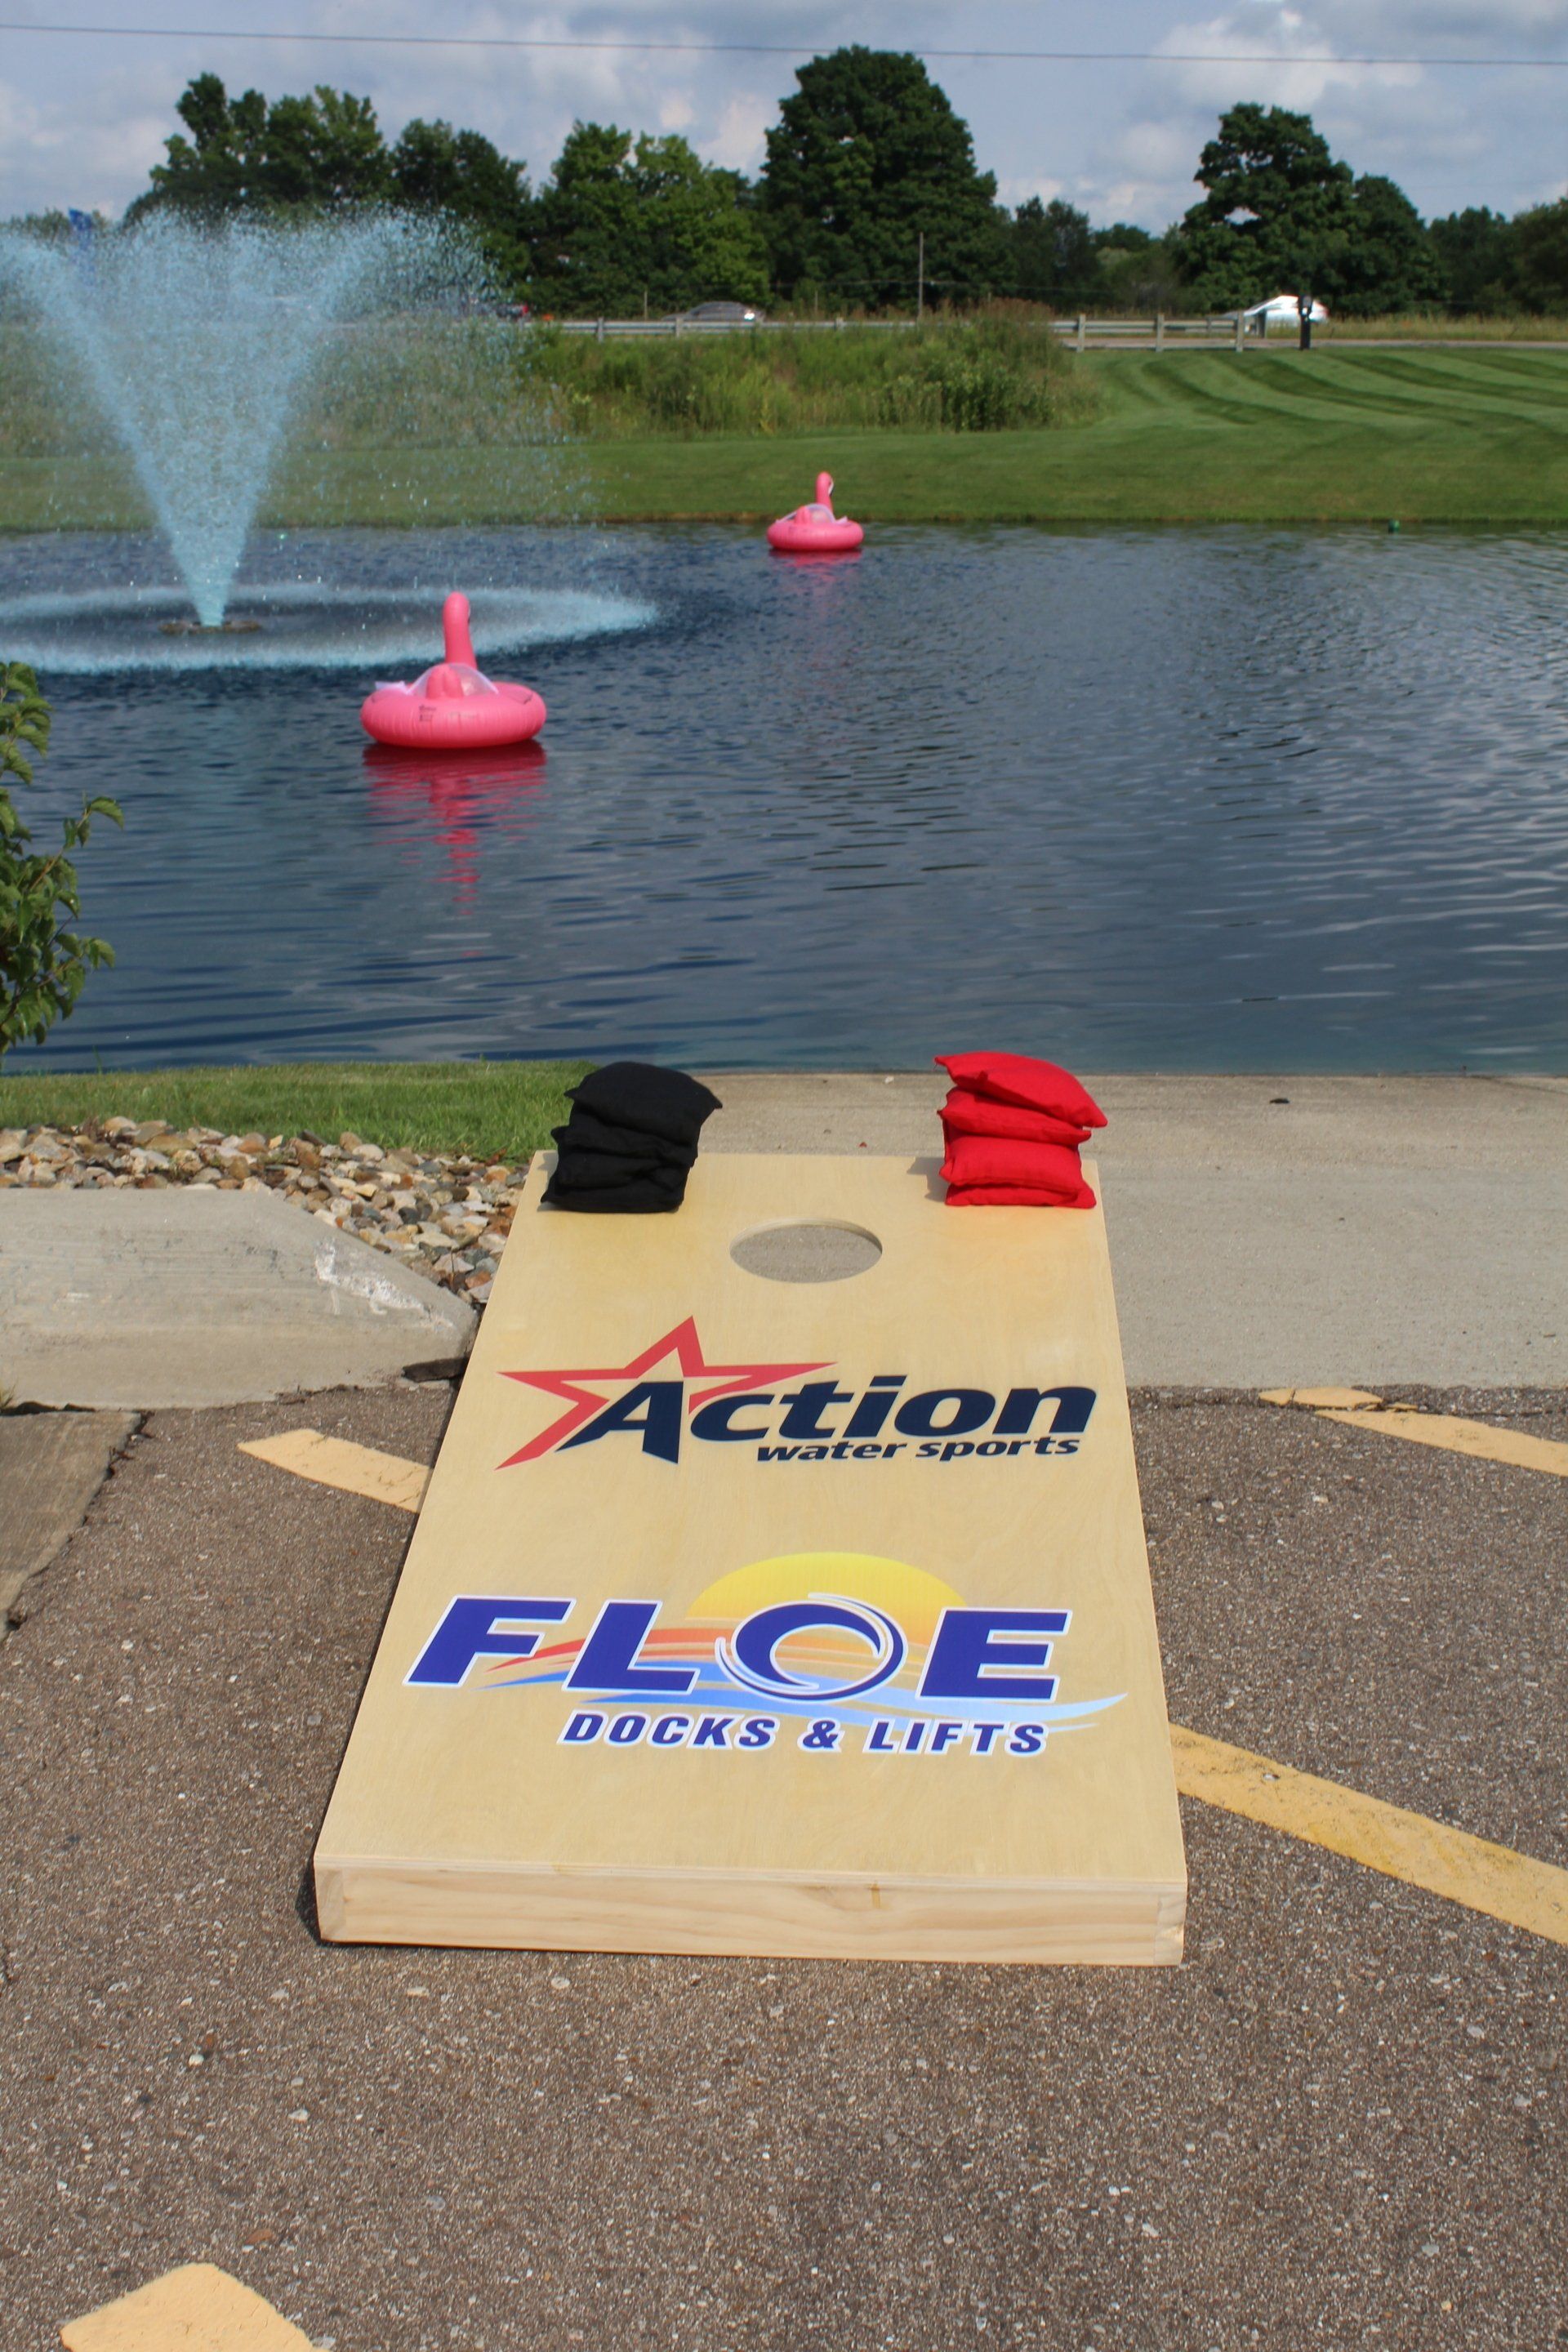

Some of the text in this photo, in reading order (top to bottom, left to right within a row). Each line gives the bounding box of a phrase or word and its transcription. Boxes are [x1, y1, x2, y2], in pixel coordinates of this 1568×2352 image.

[556, 1374, 1097, 1464] Action
[757, 1437, 1080, 1462] water sports
[403, 1593, 1072, 1702] FLOE
[558, 1711, 1048, 1756] DOCKS & LIFTS
